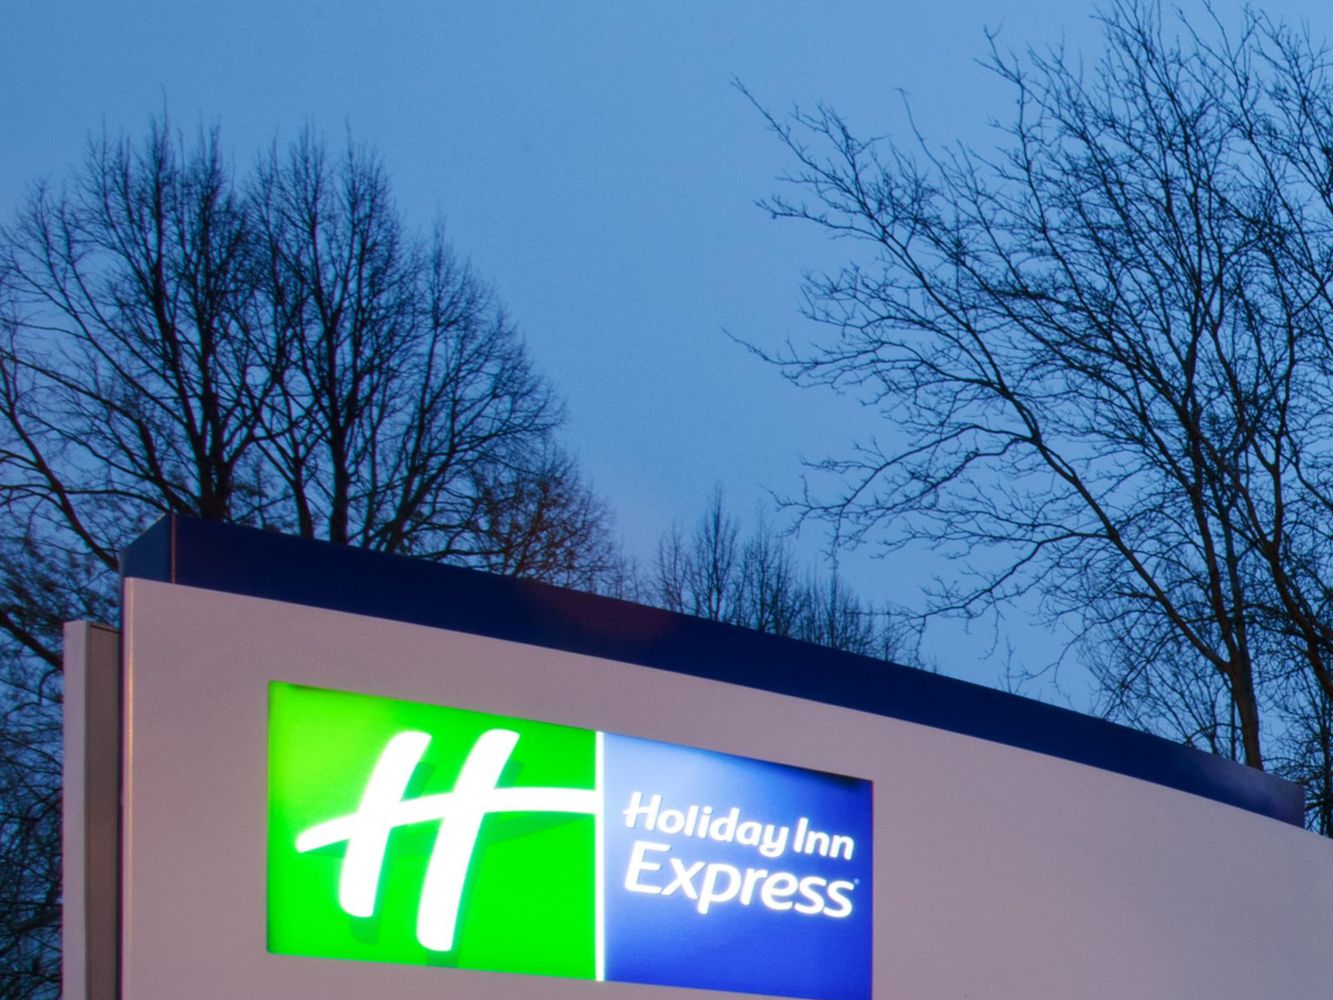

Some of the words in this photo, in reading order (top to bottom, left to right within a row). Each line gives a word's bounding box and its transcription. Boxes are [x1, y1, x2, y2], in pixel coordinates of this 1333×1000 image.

[623, 791, 789, 858] Holiday
[794, 817, 855, 860] Inn
[624, 840, 856, 918] Express
